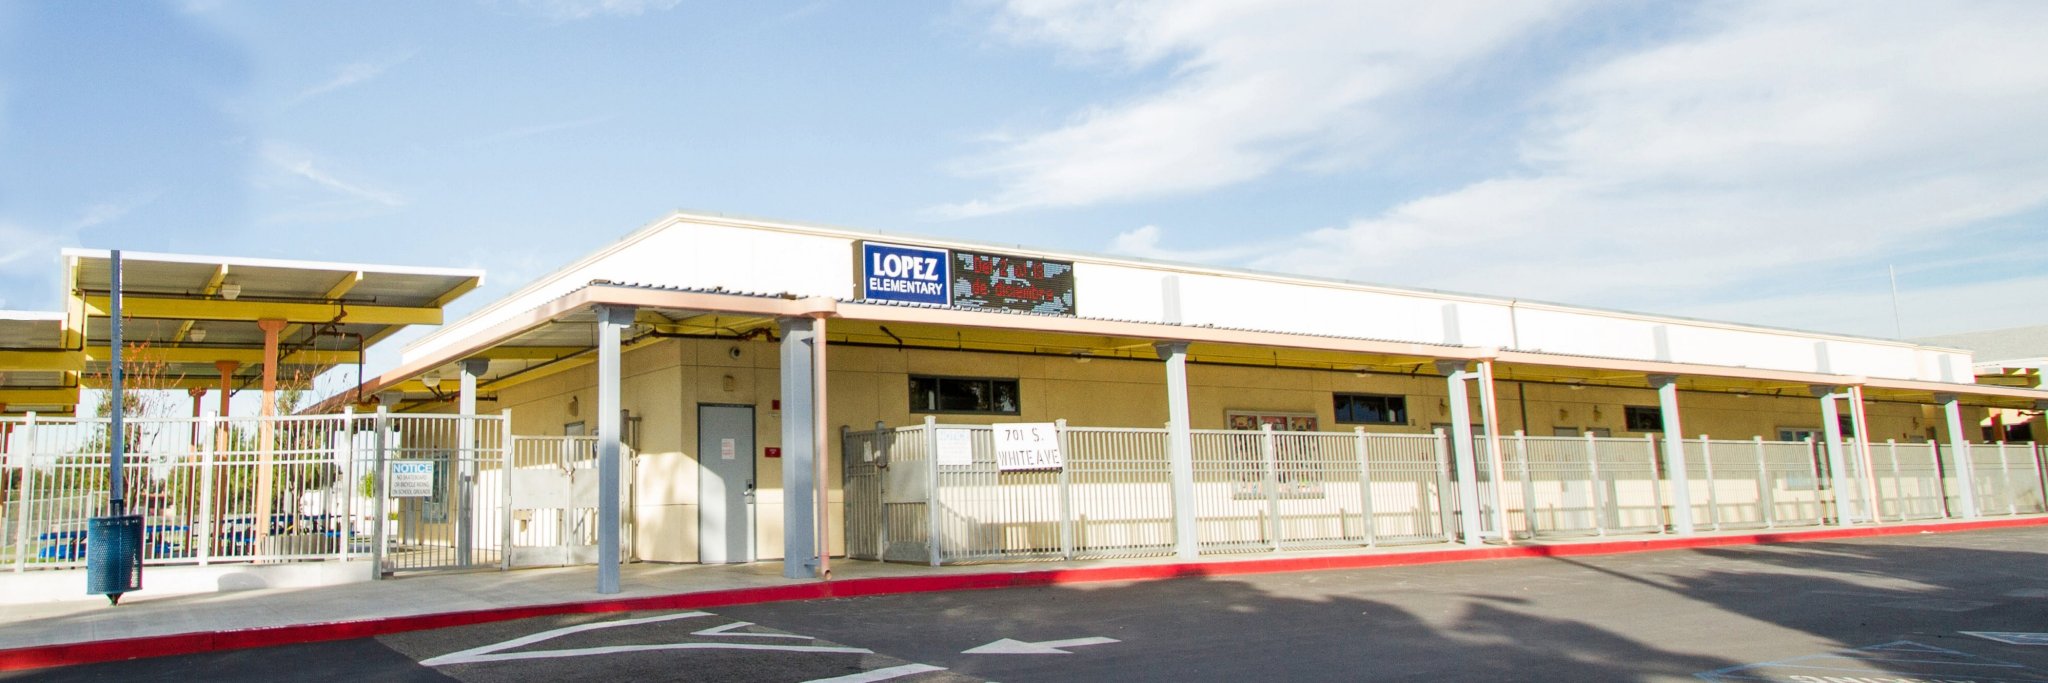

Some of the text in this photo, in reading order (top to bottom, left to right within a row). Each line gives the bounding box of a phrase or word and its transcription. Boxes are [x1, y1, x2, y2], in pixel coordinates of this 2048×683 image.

[873, 252, 939, 281] LOPEZ
[999, 257, 1008, 277] 2
[869, 277, 943, 296] ELEMENTARY
[973, 279, 988, 297] de
[1005, 427, 1044, 442] 701 S.
[998, 449, 1060, 467] WHITE AVE
[393, 463, 433, 473] NOTICE
